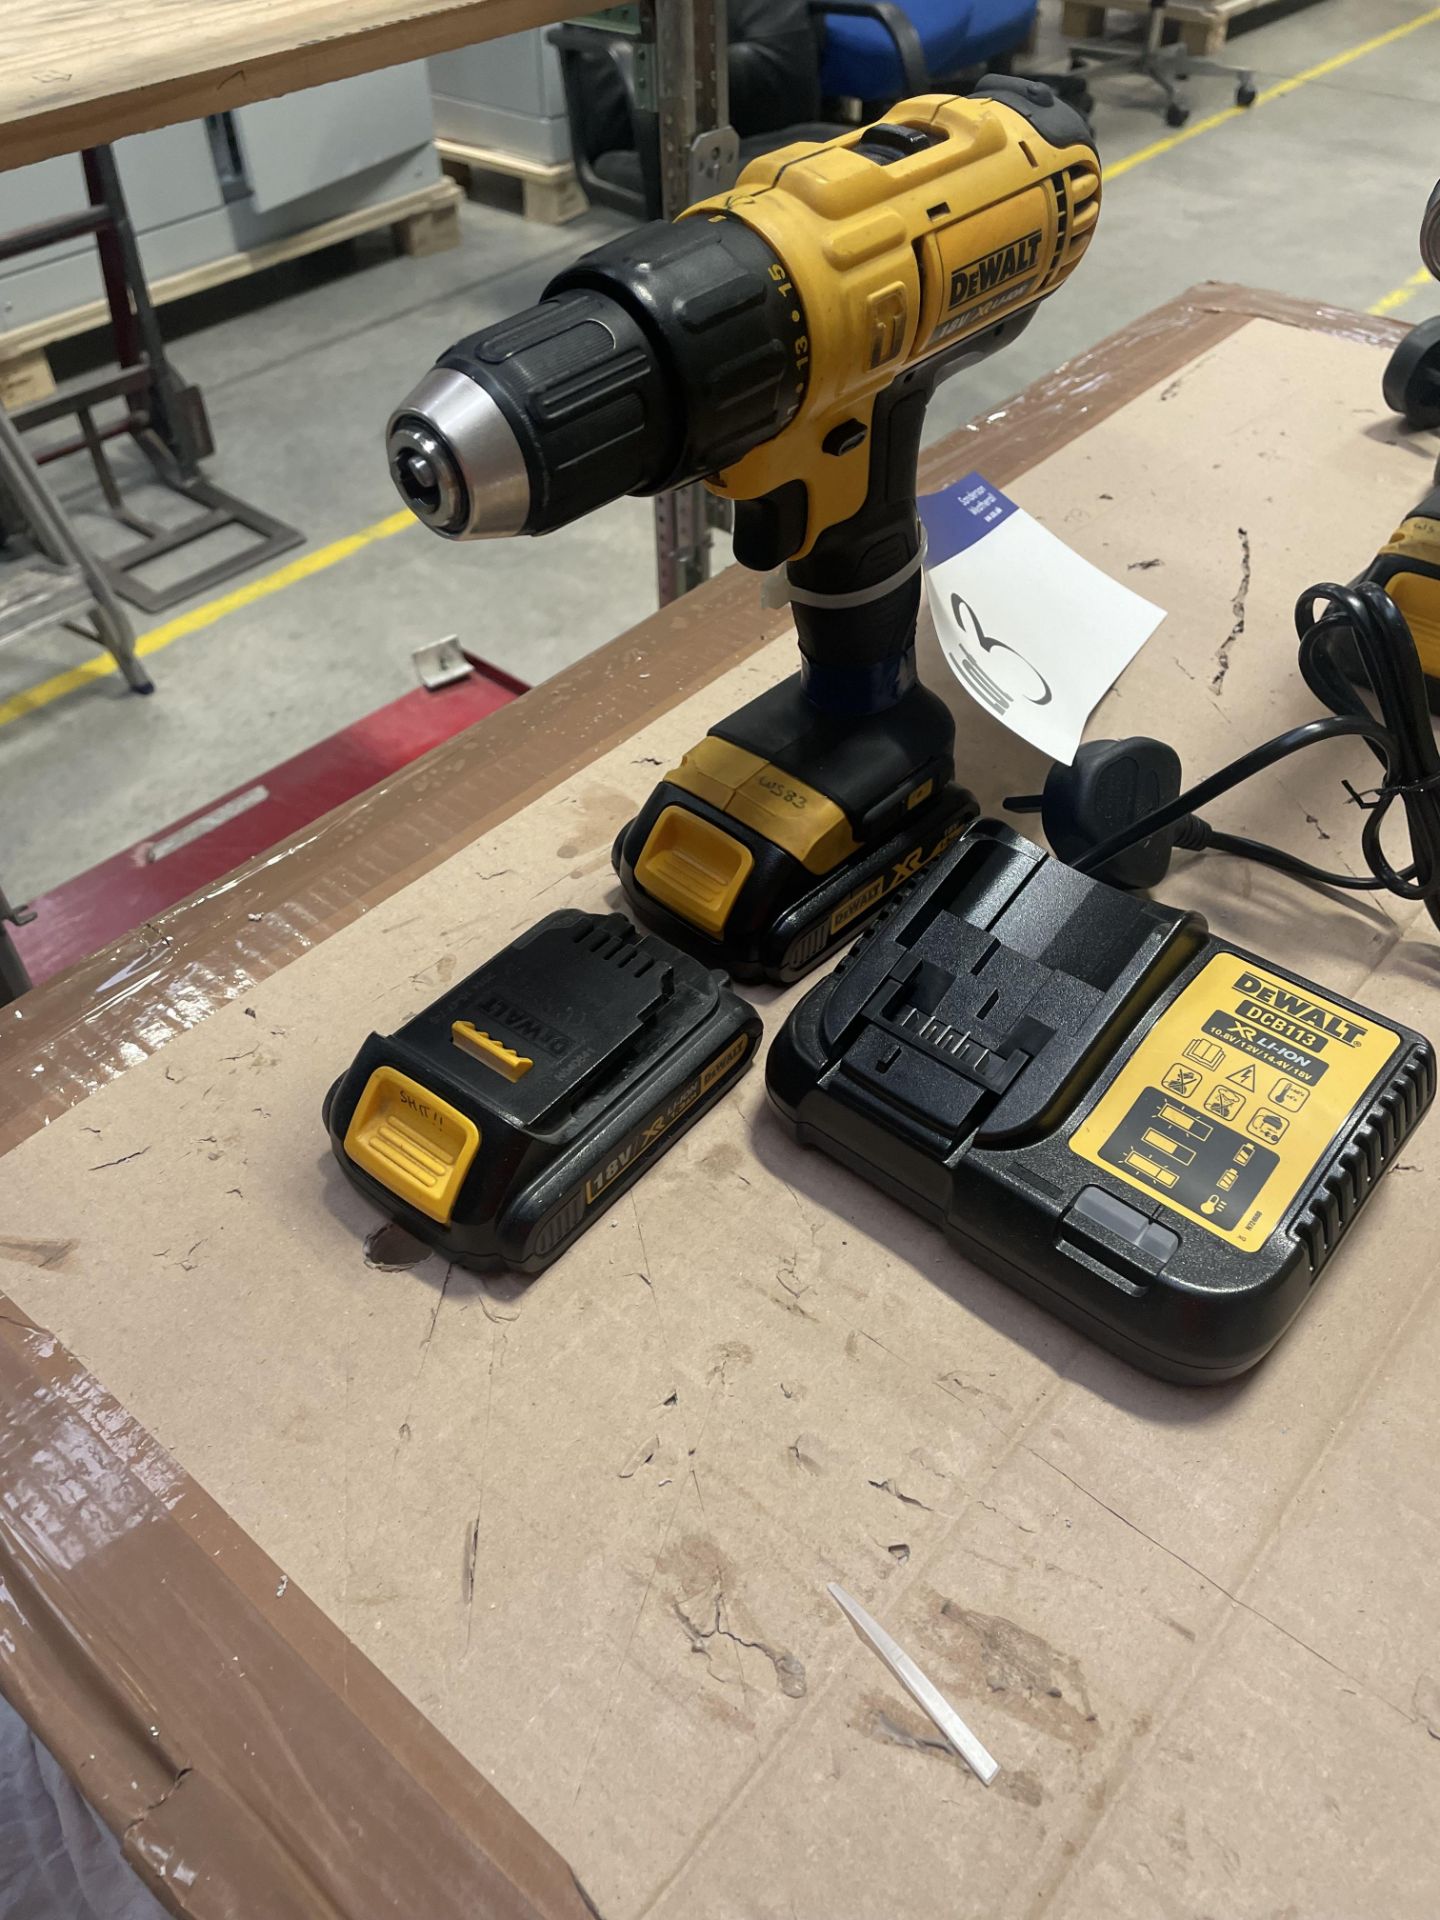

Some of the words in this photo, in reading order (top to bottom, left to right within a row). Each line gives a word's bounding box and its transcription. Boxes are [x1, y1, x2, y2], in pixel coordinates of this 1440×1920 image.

[768, 263, 792, 297] 15
[949, 231, 1042, 307] DEWALT
[794, 335, 808, 370] 13
[950, 592, 1053, 706] 3
[1233, 972, 1367, 1043] DEWALT
[1246, 1006, 1316, 1046] DCB113
[1227, 1021, 1257, 1042] XR
[1257, 1038, 1312, 1067] LI-ION
[593, 1144, 632, 1190] 18V
[641, 1115, 666, 1145] XR
